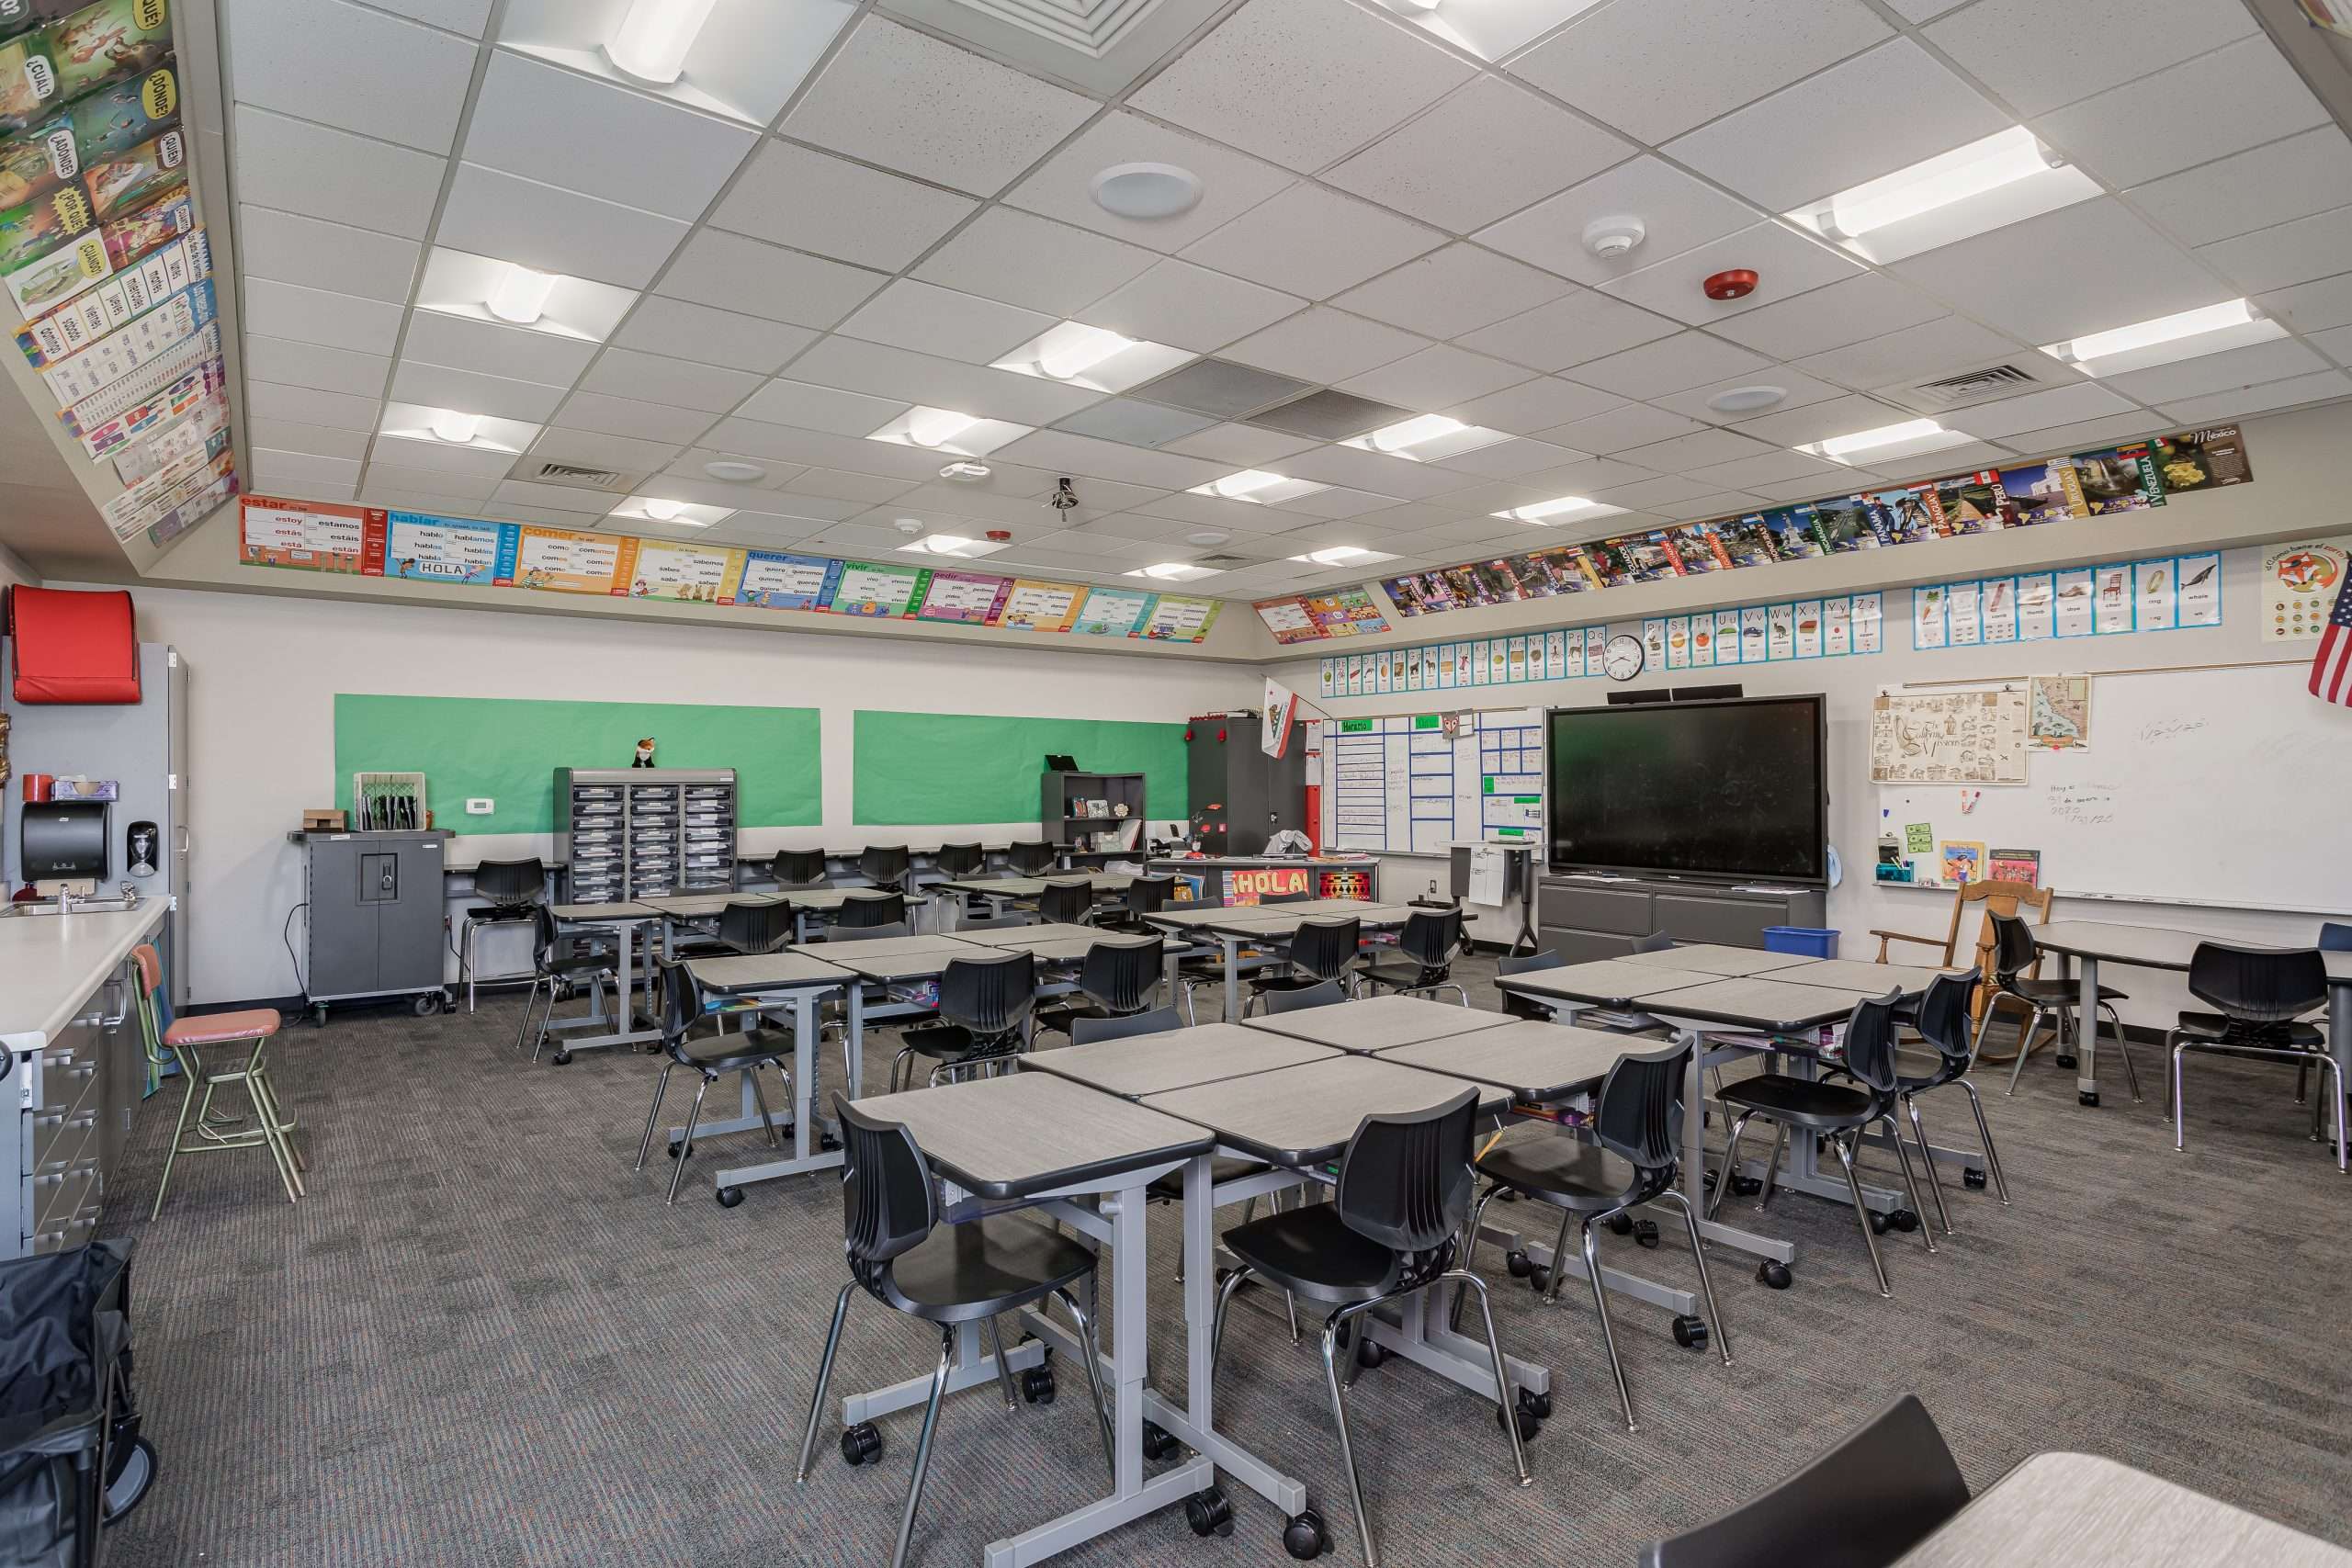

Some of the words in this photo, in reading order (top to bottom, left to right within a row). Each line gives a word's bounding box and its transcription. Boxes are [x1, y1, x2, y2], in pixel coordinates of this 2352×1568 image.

[143, 0, 161, 27] QUÉ?
[26, 60, 51, 96] ¿CUÁL?
[149, 73, 168, 118] ¿DÓNDE?
[50, 135, 74, 175] ¿ADÓNDE?
[59, 192, 78, 211] ¿POR
[170, 259, 183, 279] lunes
[149, 270, 164, 293] martes
[40, 327, 61, 355] domingo
[2189, 428, 2236, 444] México
[2141, 457, 2162, 502] VENEZUELA
[241, 498, 288, 509] estar
[1991, 483, 2009, 506] PERÚ
[276, 516, 302, 525] estoy
[390, 513, 440, 526] hablar
[1927, 493, 1946, 529] PARAGUAY
[319, 521, 359, 529] estamos
[1814, 518, 1832, 552] NICARAGUA
[454, 535, 494, 543] hablamos
[1759, 527, 1780, 559] HONDURAS
[418, 553, 441, 561] habla
[750, 551, 787, 561] querer
[1617, 546, 1638, 575] ECUADOR
[423, 563, 463, 574] HOLA
[1471, 573, 1488, 595] BOLIVIA
[1232, 871, 1309, 895] ¡HOLA!
